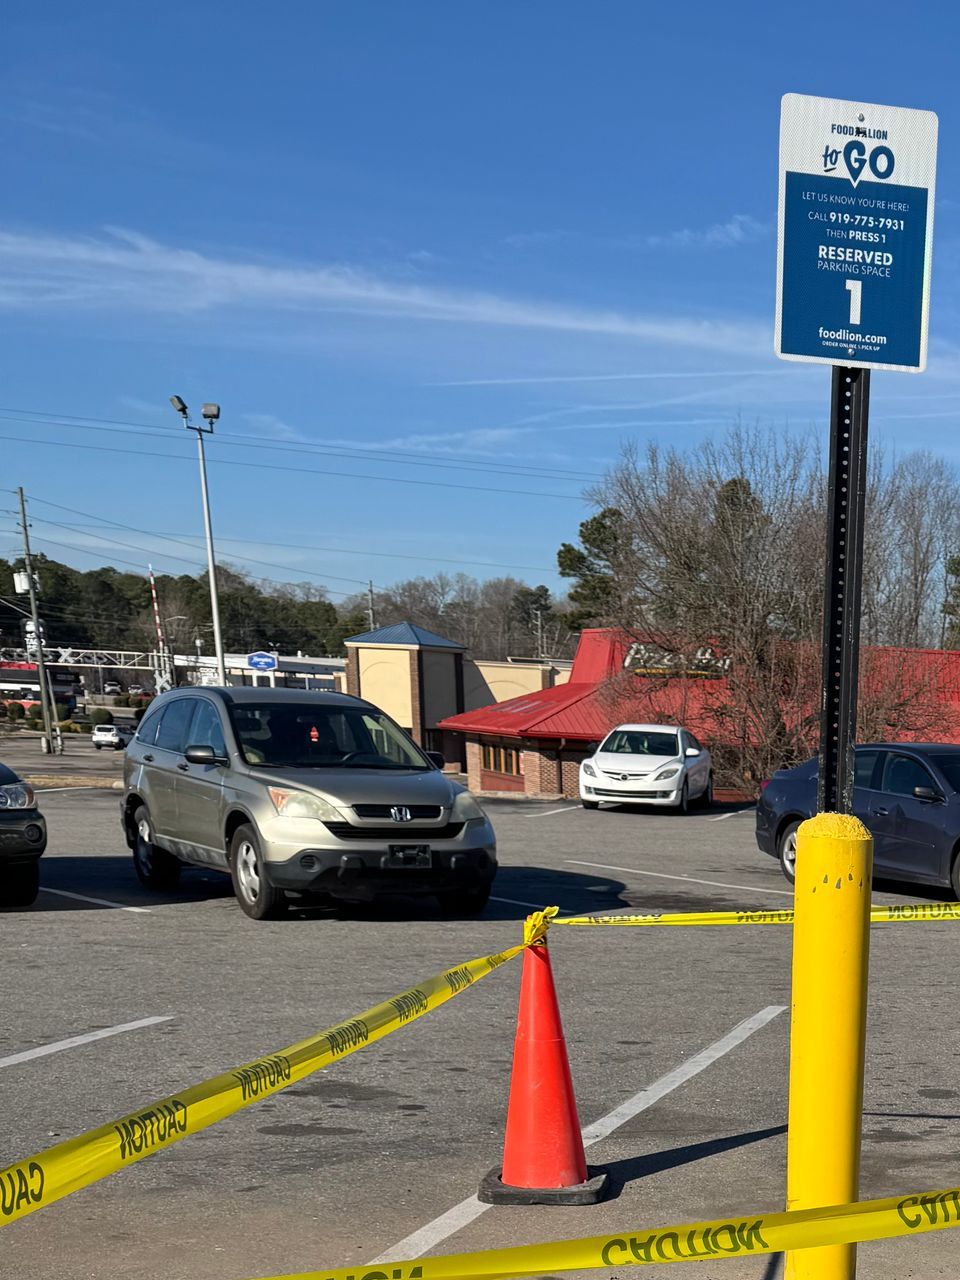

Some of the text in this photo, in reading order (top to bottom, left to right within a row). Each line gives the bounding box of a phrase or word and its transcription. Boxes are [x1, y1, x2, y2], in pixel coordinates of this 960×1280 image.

[831, 123, 888, 140] FOOD LION
[822, 139, 895, 184] to GO
[802, 191, 910, 212] LET US KNOW YOU'RE HERE!
[808, 211, 904, 231] CALL 919-775-7931
[826, 228, 886, 243] THEN PRESS 1
[818, 245, 893, 266] RESERVED
[817, 261, 891, 278] PARKING SPACE
[845, 279, 862, 325] 1
[818, 327, 887, 344] foodlion.com
